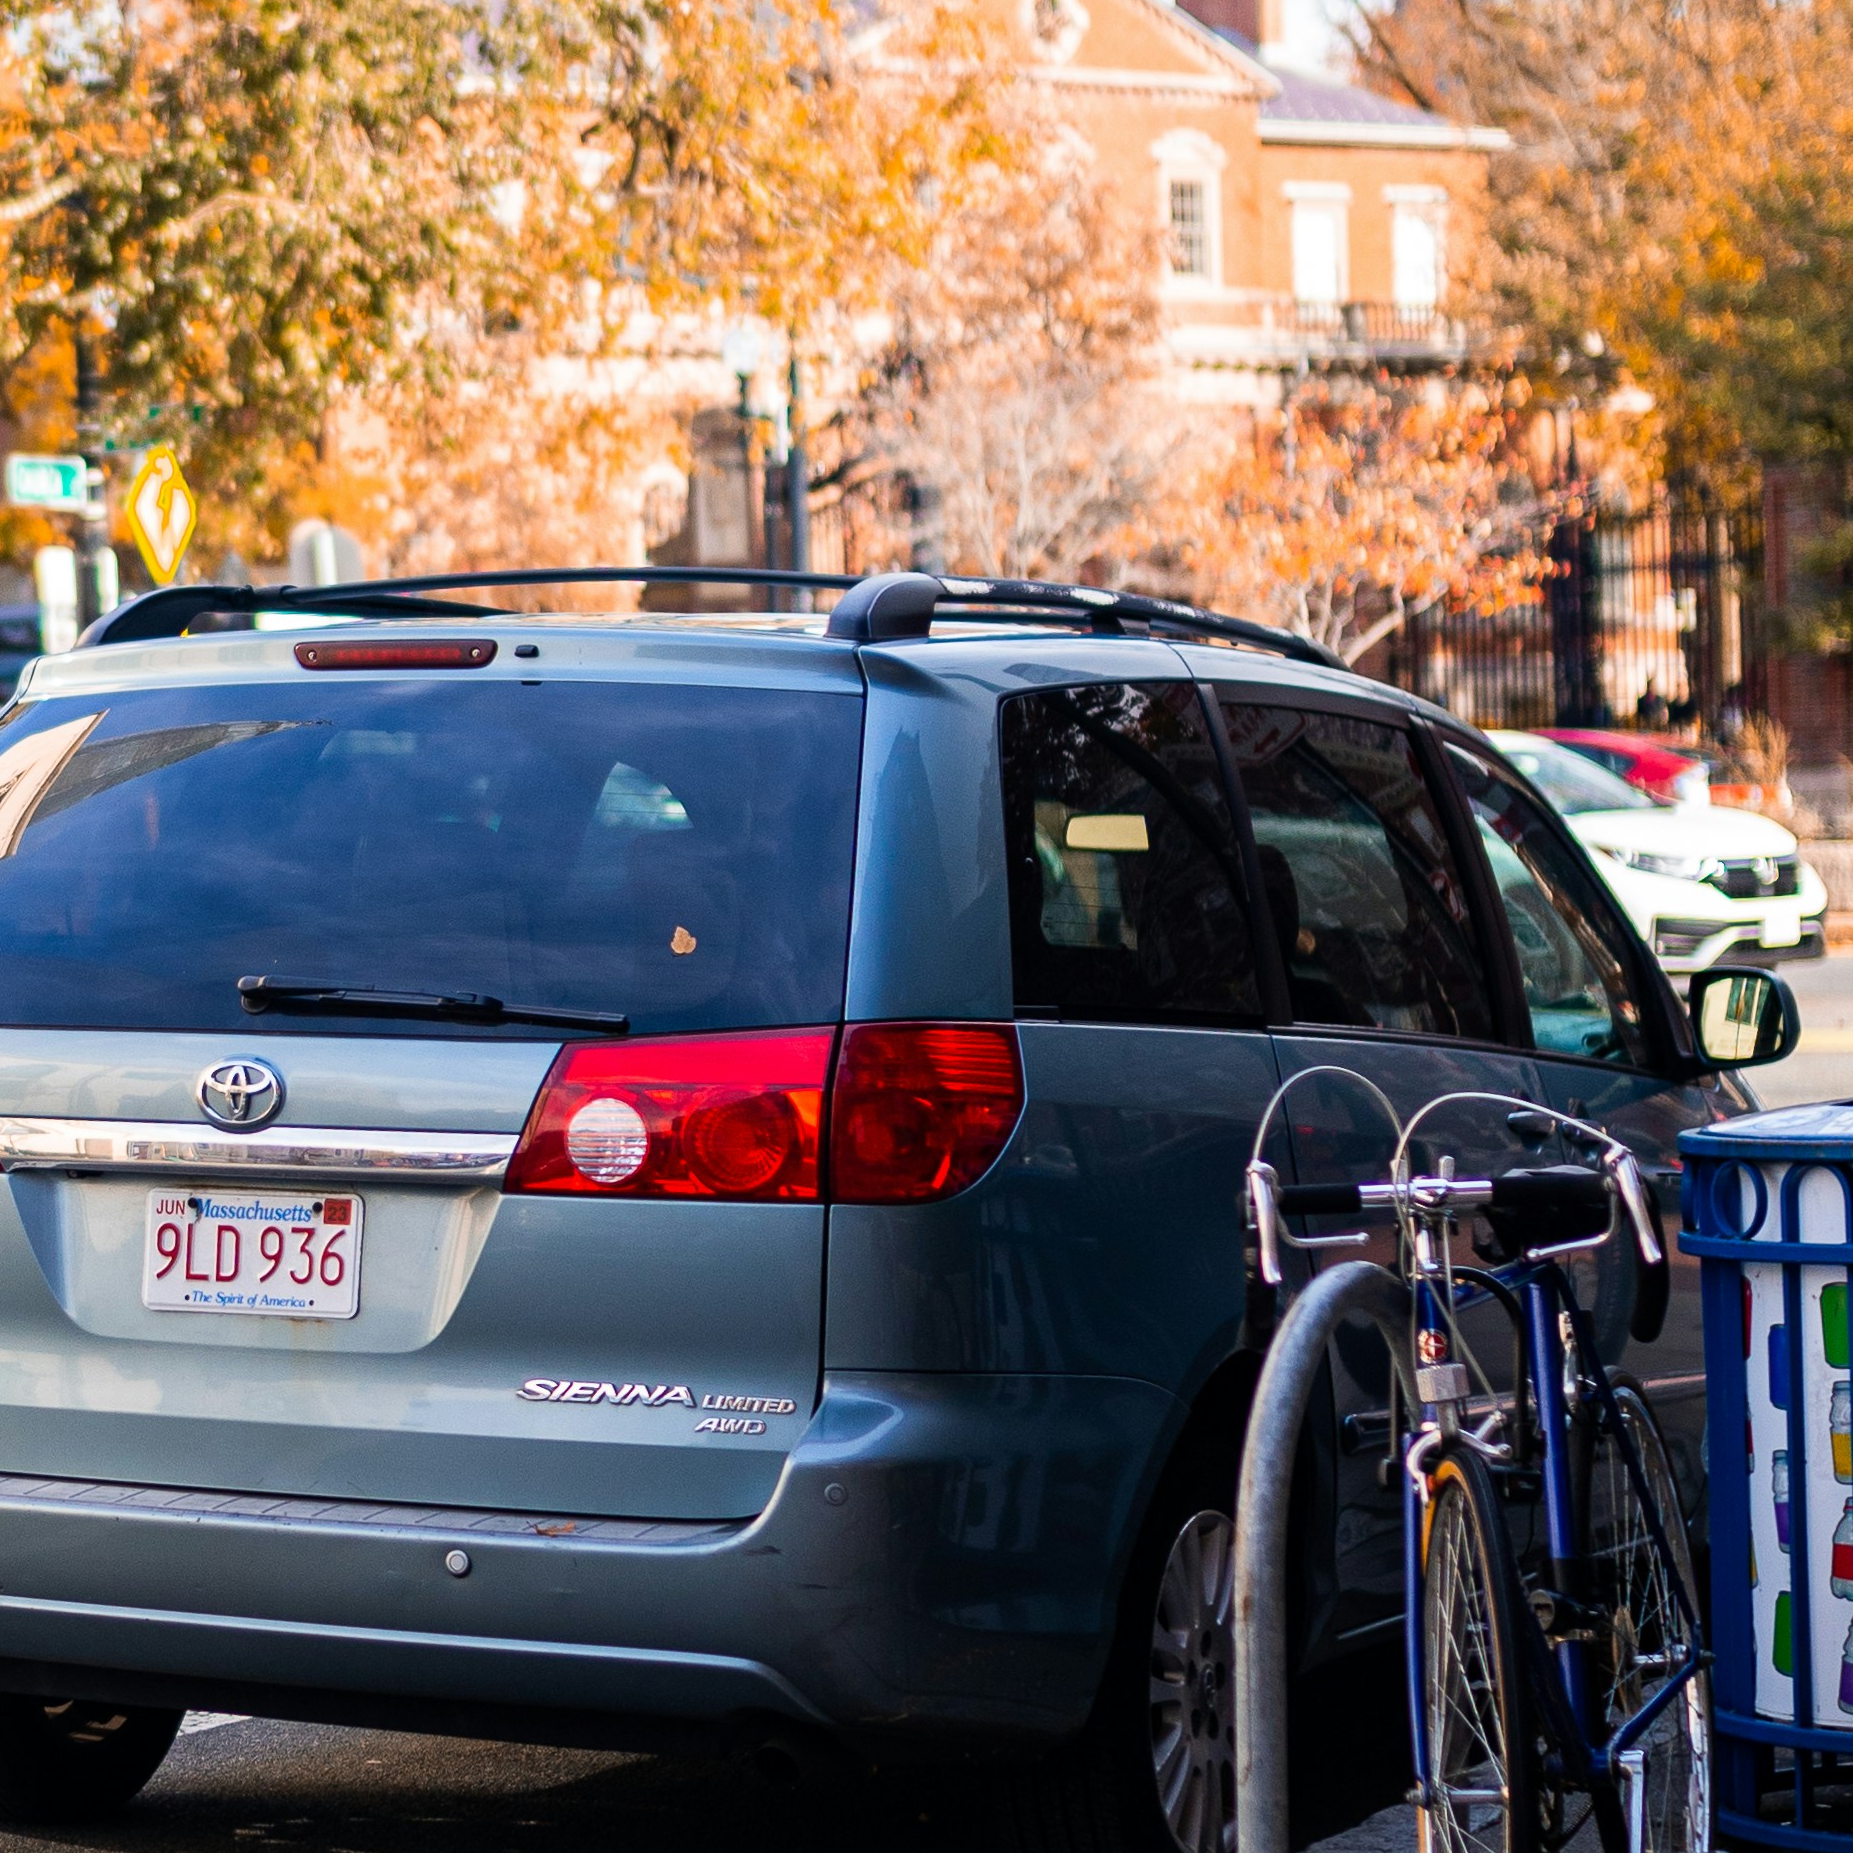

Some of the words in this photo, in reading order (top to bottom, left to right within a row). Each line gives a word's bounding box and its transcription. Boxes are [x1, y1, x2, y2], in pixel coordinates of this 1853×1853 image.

[156, 1199, 186, 1216] JUN
[196, 1198, 313, 1223] Massachusetts
[327, 1205, 347, 1223] 23
[155, 1222, 241, 1282] 9LD
[259, 1225, 346, 1287] 936
[191, 1290, 212, 1303] The
[215, 1291, 244, 1307] Spirit
[247, 1293, 258, 1308] of
[260, 1296, 306, 1308] America
[515, 1377, 698, 1408] SIENNA
[701, 1393, 797, 1414] LIMITED
[694, 1416, 767, 1435] AWD
